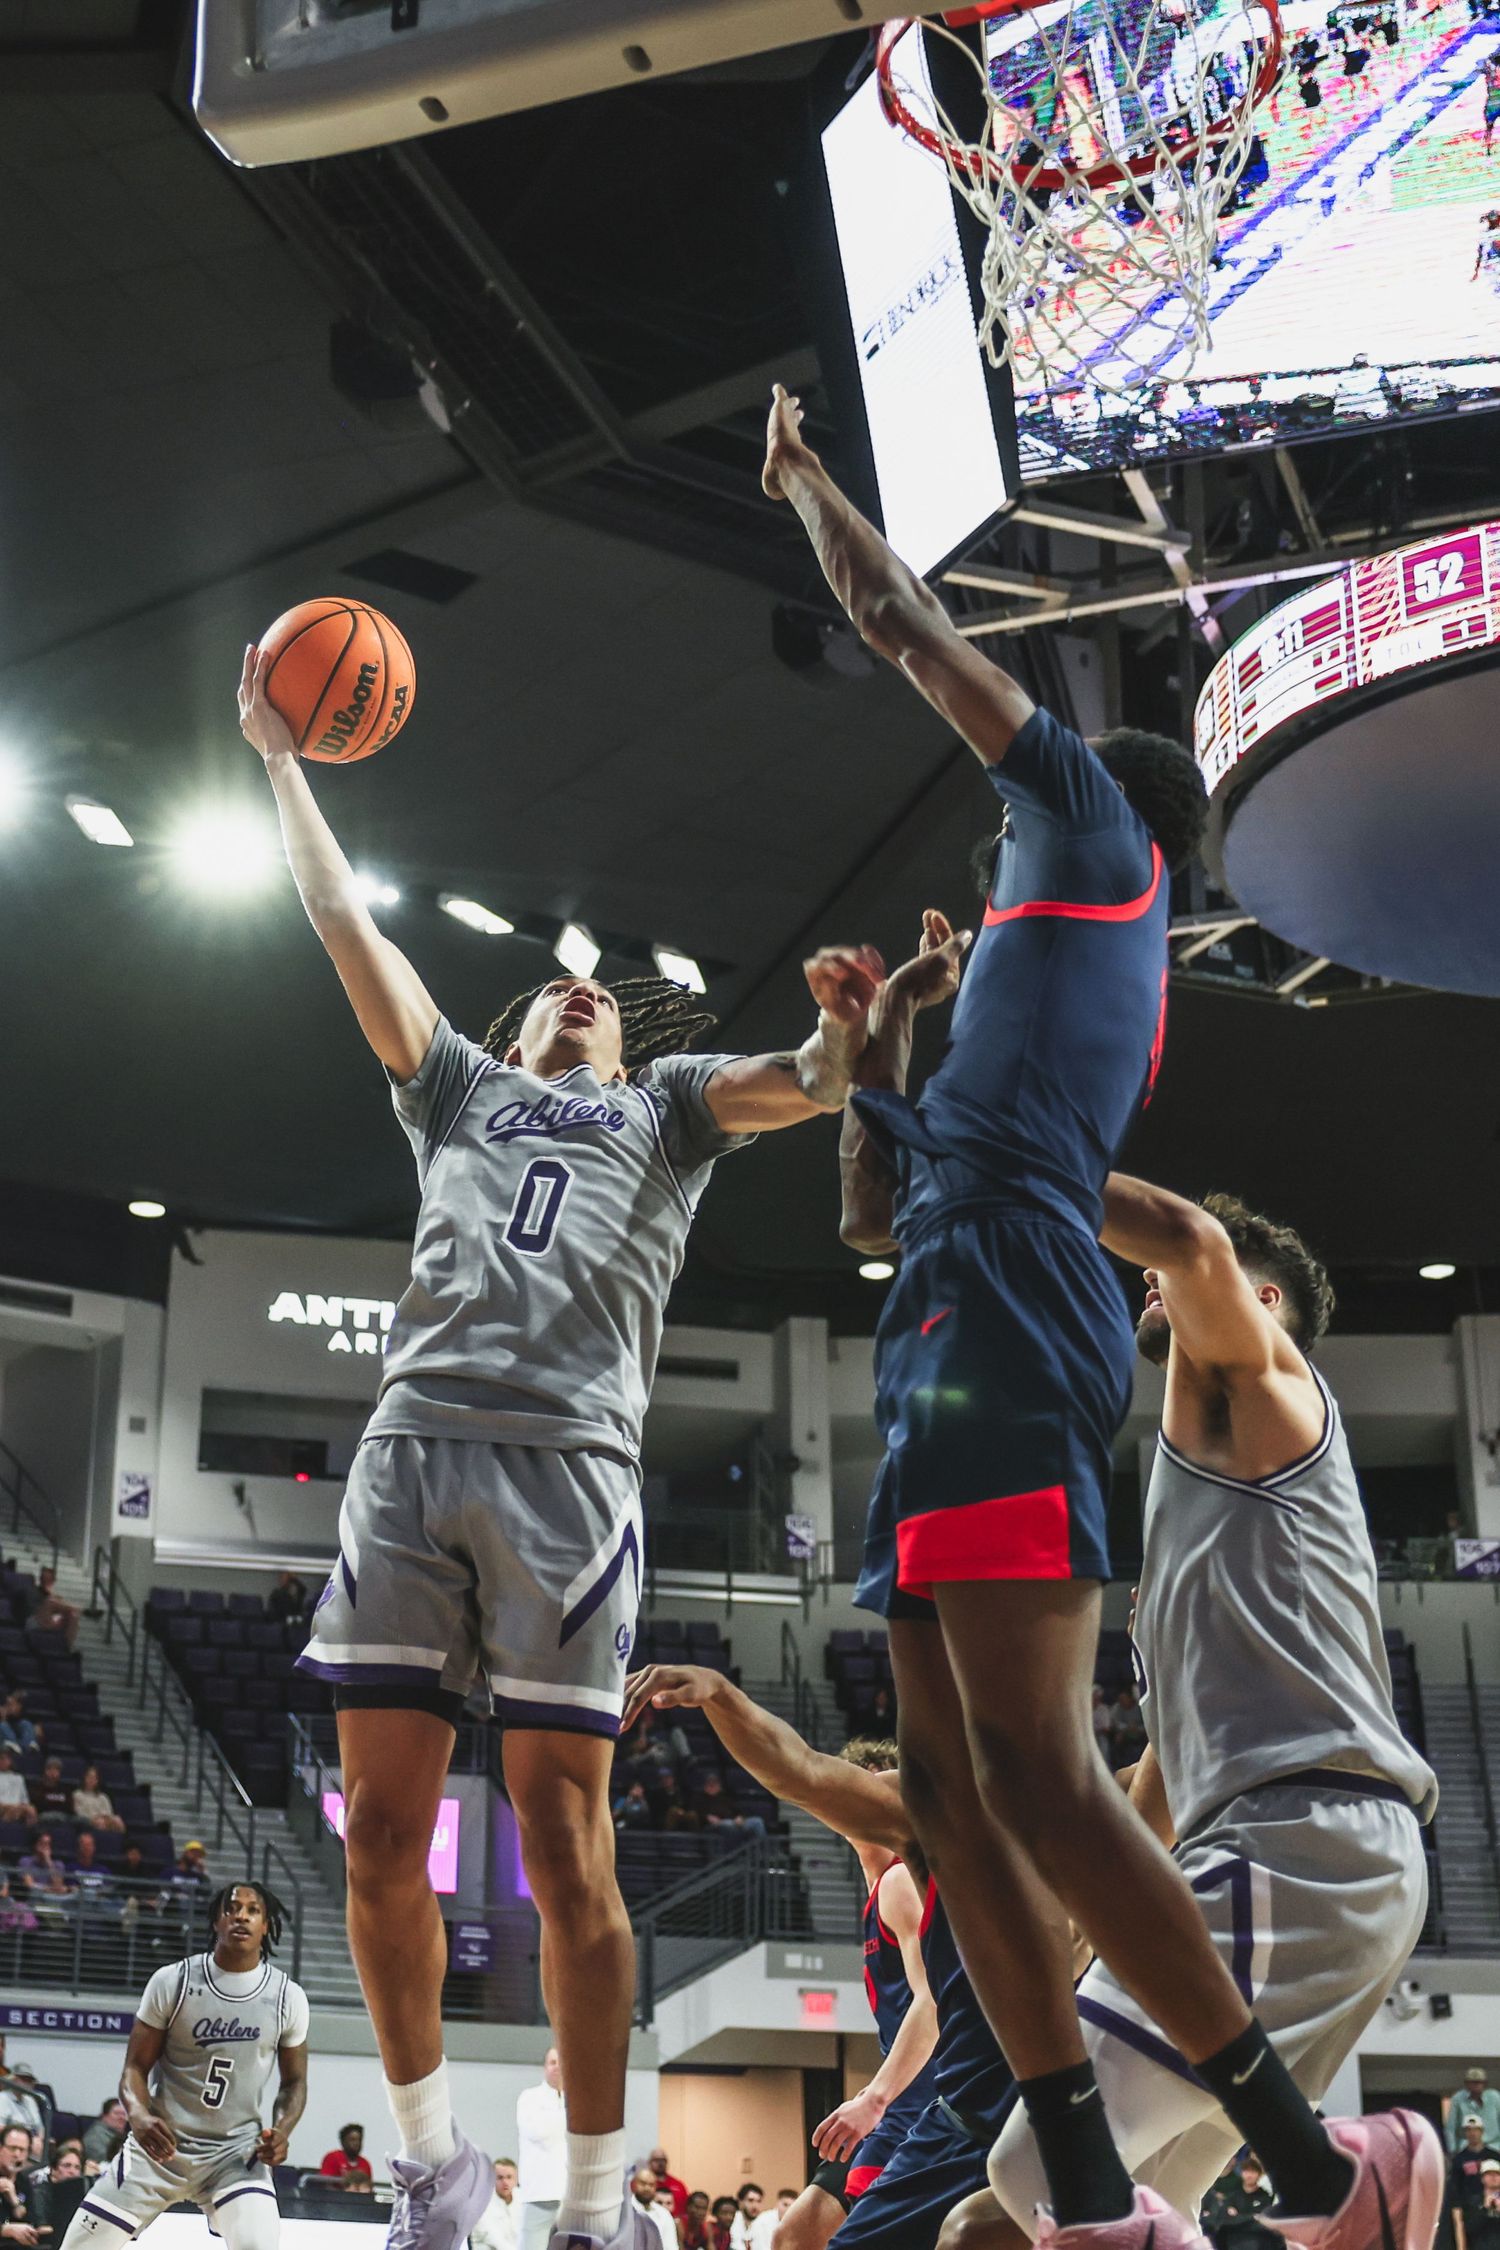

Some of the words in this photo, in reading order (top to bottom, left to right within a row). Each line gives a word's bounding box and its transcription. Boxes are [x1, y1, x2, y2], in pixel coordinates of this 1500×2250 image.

[1413, 551, 1465, 603] 52
[312, 661, 378, 756] Wilson
[484, 1094, 626, 1144] Abilene
[502, 1156, 576, 1258] 0
[8, 2009, 121, 2030] SECTION
[192, 2017, 260, 2048] Abilene
[200, 2056, 235, 2109] 5
